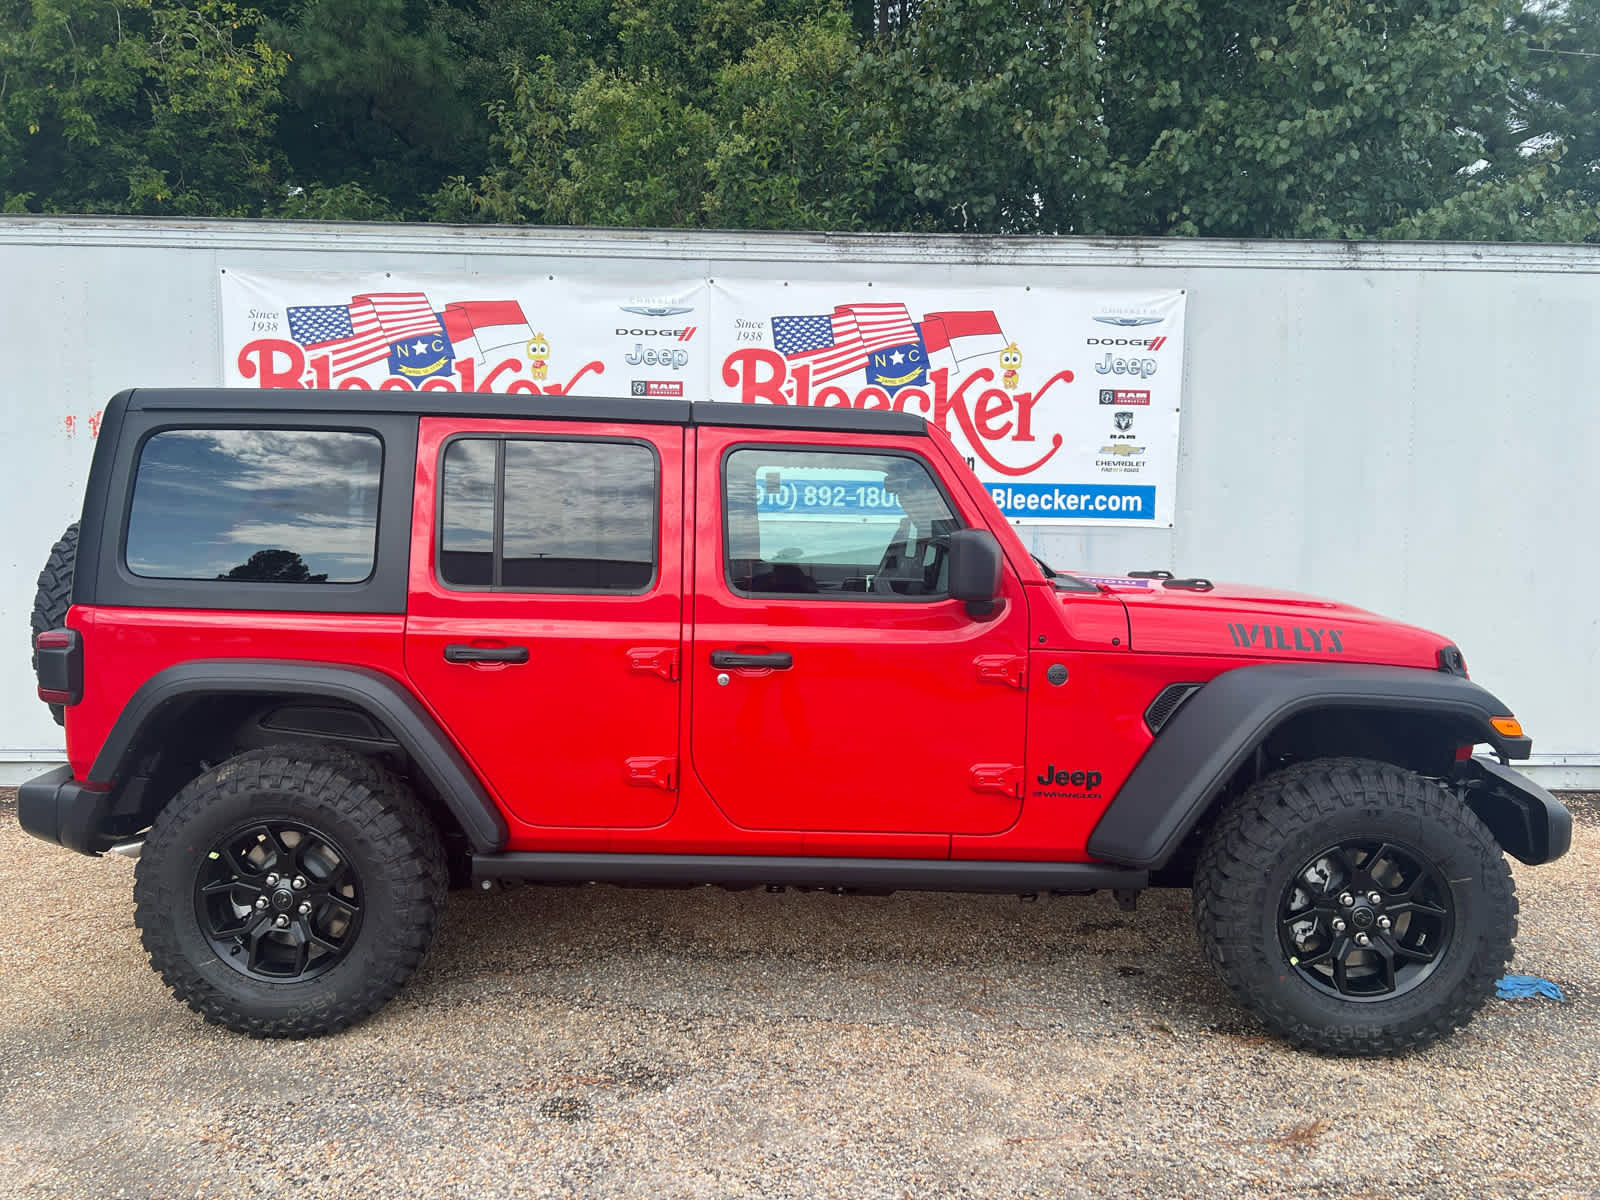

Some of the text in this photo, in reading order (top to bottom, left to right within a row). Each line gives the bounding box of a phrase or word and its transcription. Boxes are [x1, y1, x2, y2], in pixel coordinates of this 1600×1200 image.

[248, 309, 279, 320] Since
[735, 318, 764, 329] Since
[251, 322, 279, 332] 1938
[615, 328, 686, 337] DODGE
[736, 331, 763, 341] 1938
[397, 339, 444, 358] N C
[1086, 338, 1156, 346] DODGE
[624, 343, 689, 370] Jeep
[874, 349, 921, 368] N C
[1095, 352, 1157, 379] Jeep
[991, 487, 1142, 512] Bleecker.com
[1226, 623, 1344, 653] WILLYS
[1037, 764, 1103, 791] Jeep
